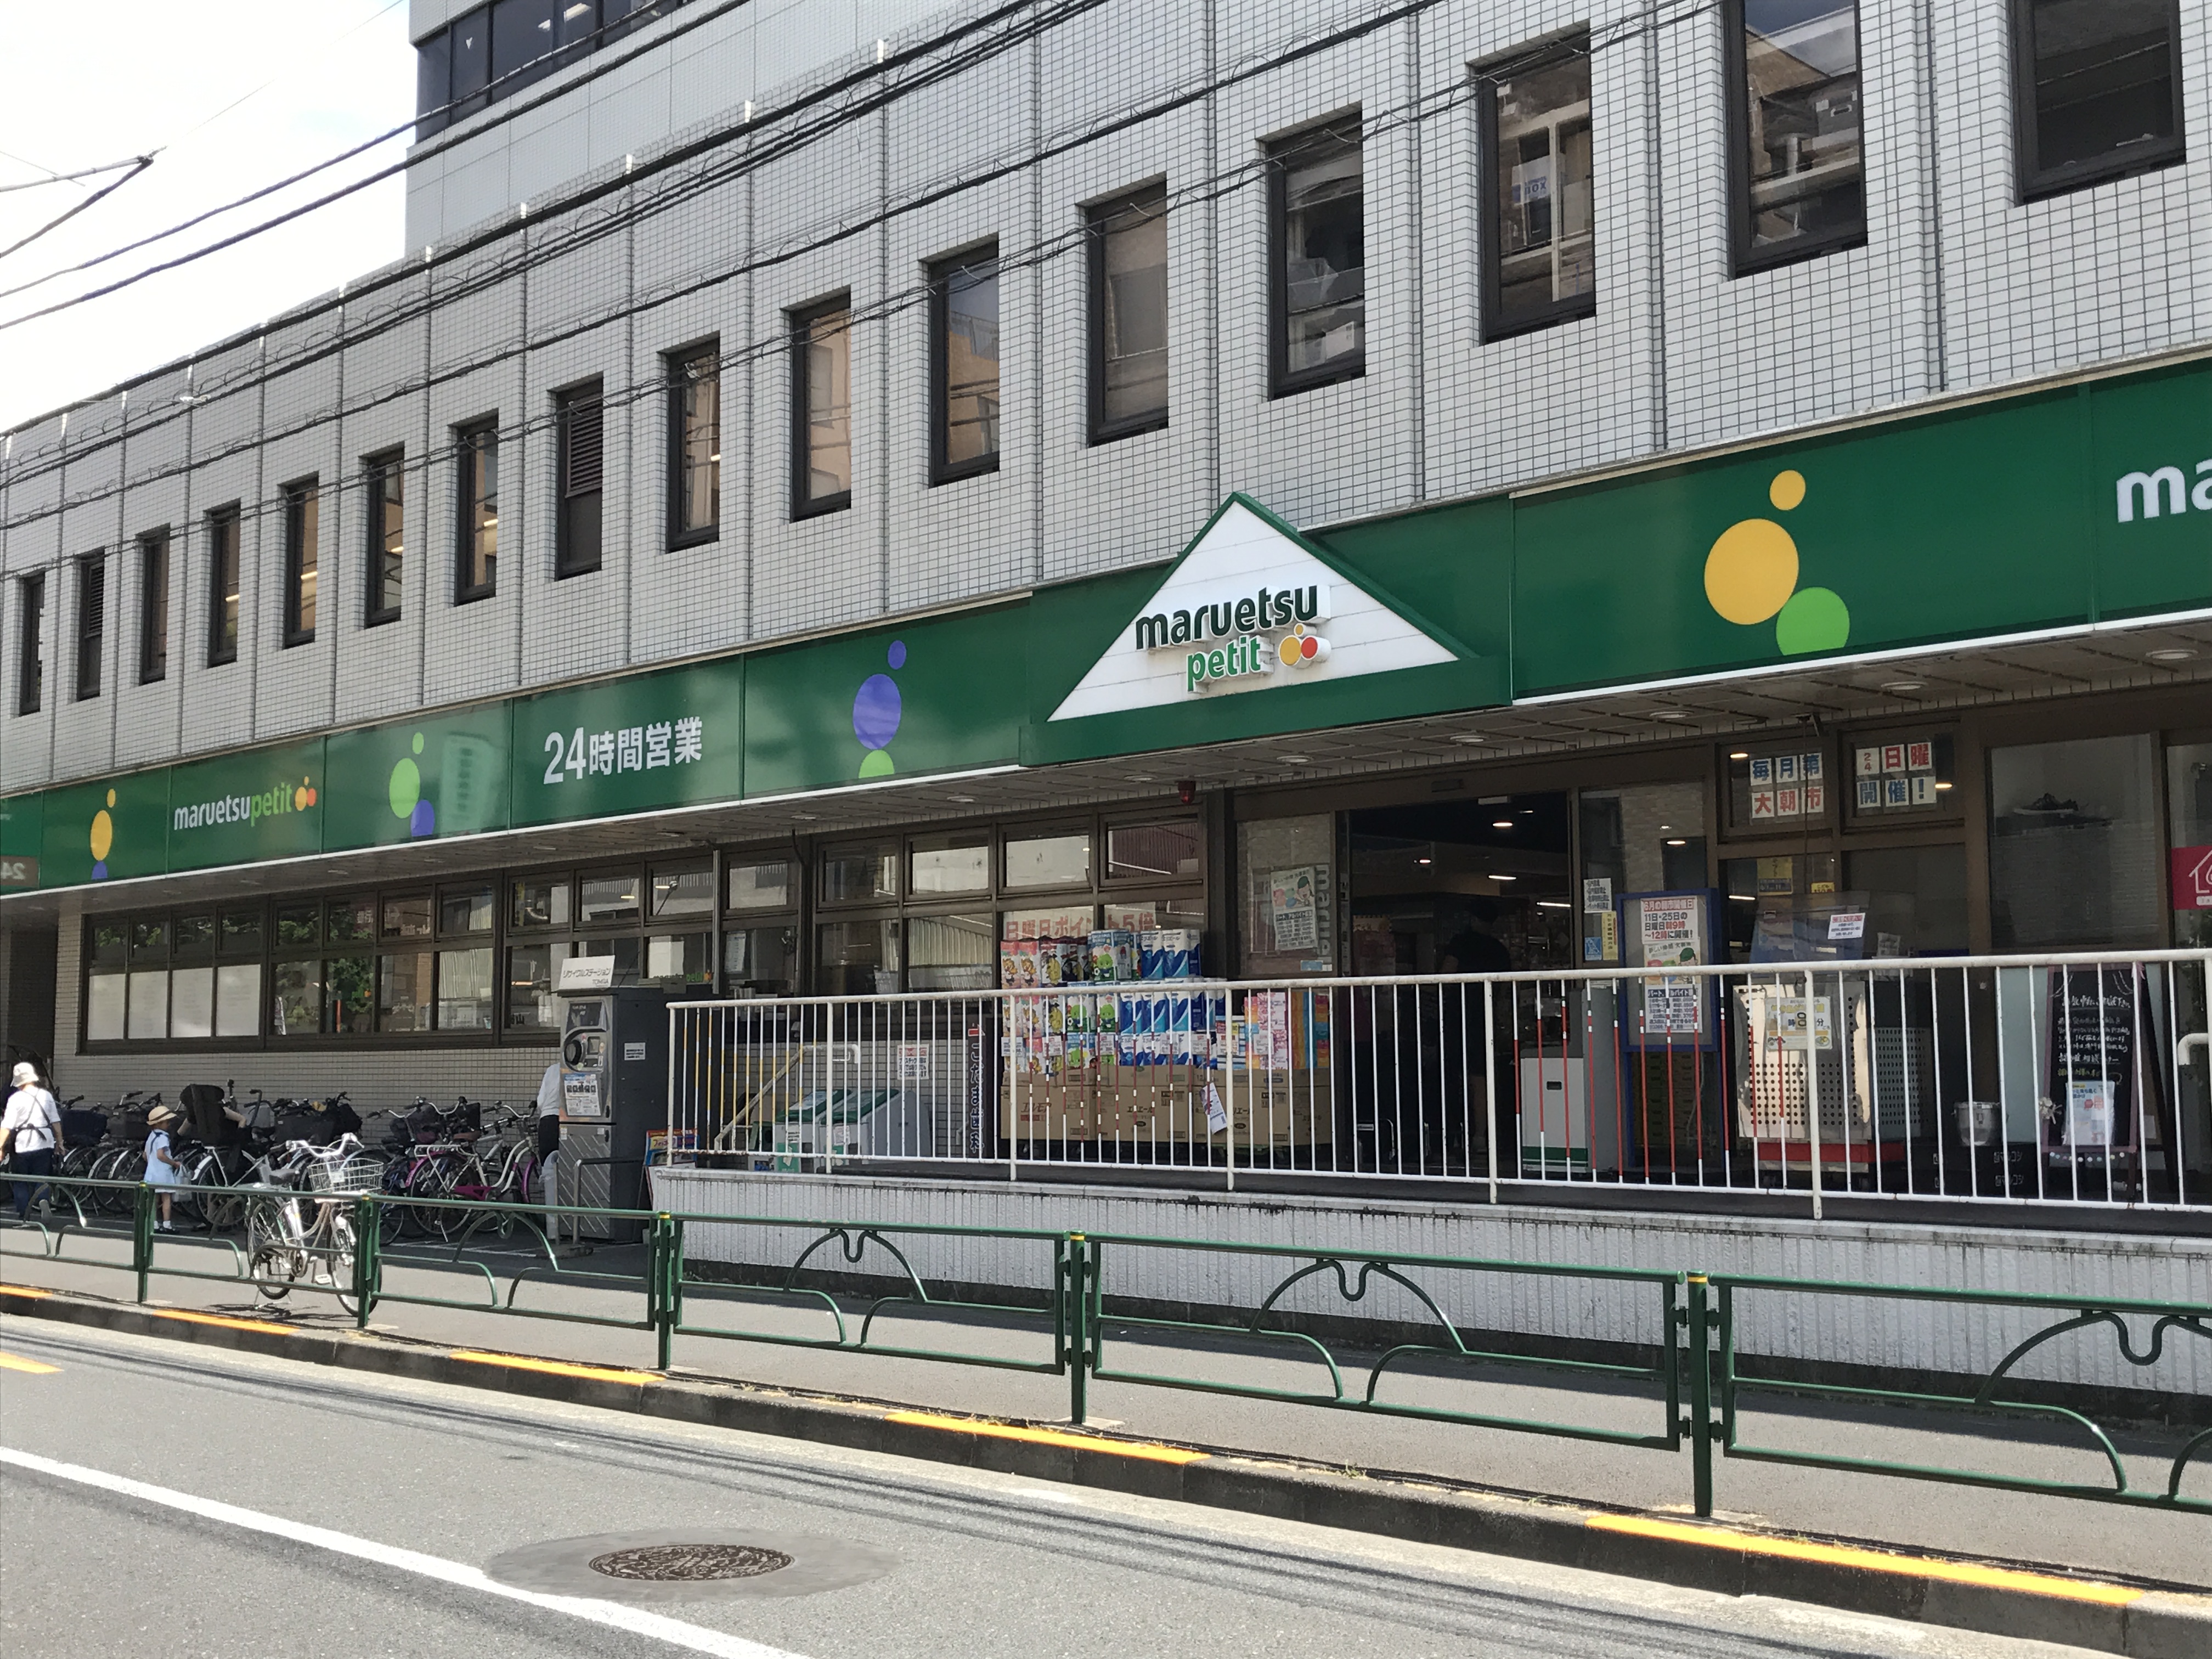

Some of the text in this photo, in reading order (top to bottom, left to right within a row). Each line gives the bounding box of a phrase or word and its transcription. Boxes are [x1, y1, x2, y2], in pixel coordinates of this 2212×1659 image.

[1136, 585, 1318, 651] maruetsu
[1187, 636, 1261, 693] petit
[543, 715, 703, 785] 24時間営業
